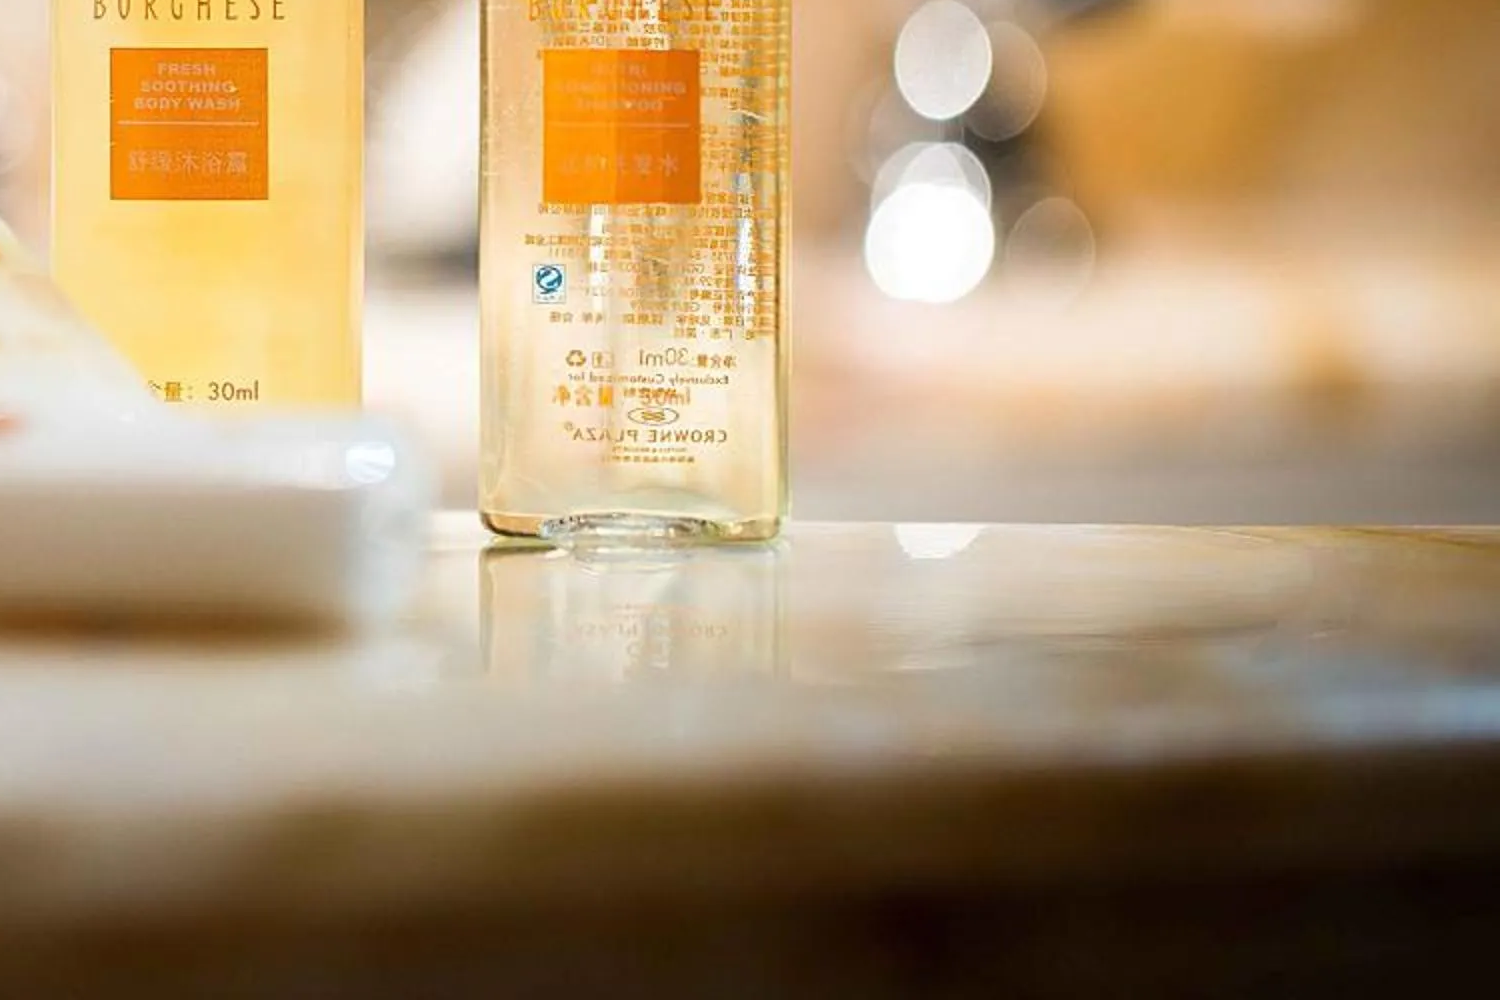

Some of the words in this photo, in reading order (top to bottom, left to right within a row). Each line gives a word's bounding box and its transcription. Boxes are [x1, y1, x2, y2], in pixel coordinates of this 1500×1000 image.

[157, 61, 217, 76] FRESH
[140, 79, 236, 93] SOOTHING
[133, 96, 184, 111] BODY
[186, 96, 241, 111] WASH
[208, 379, 260, 401] 30ml
